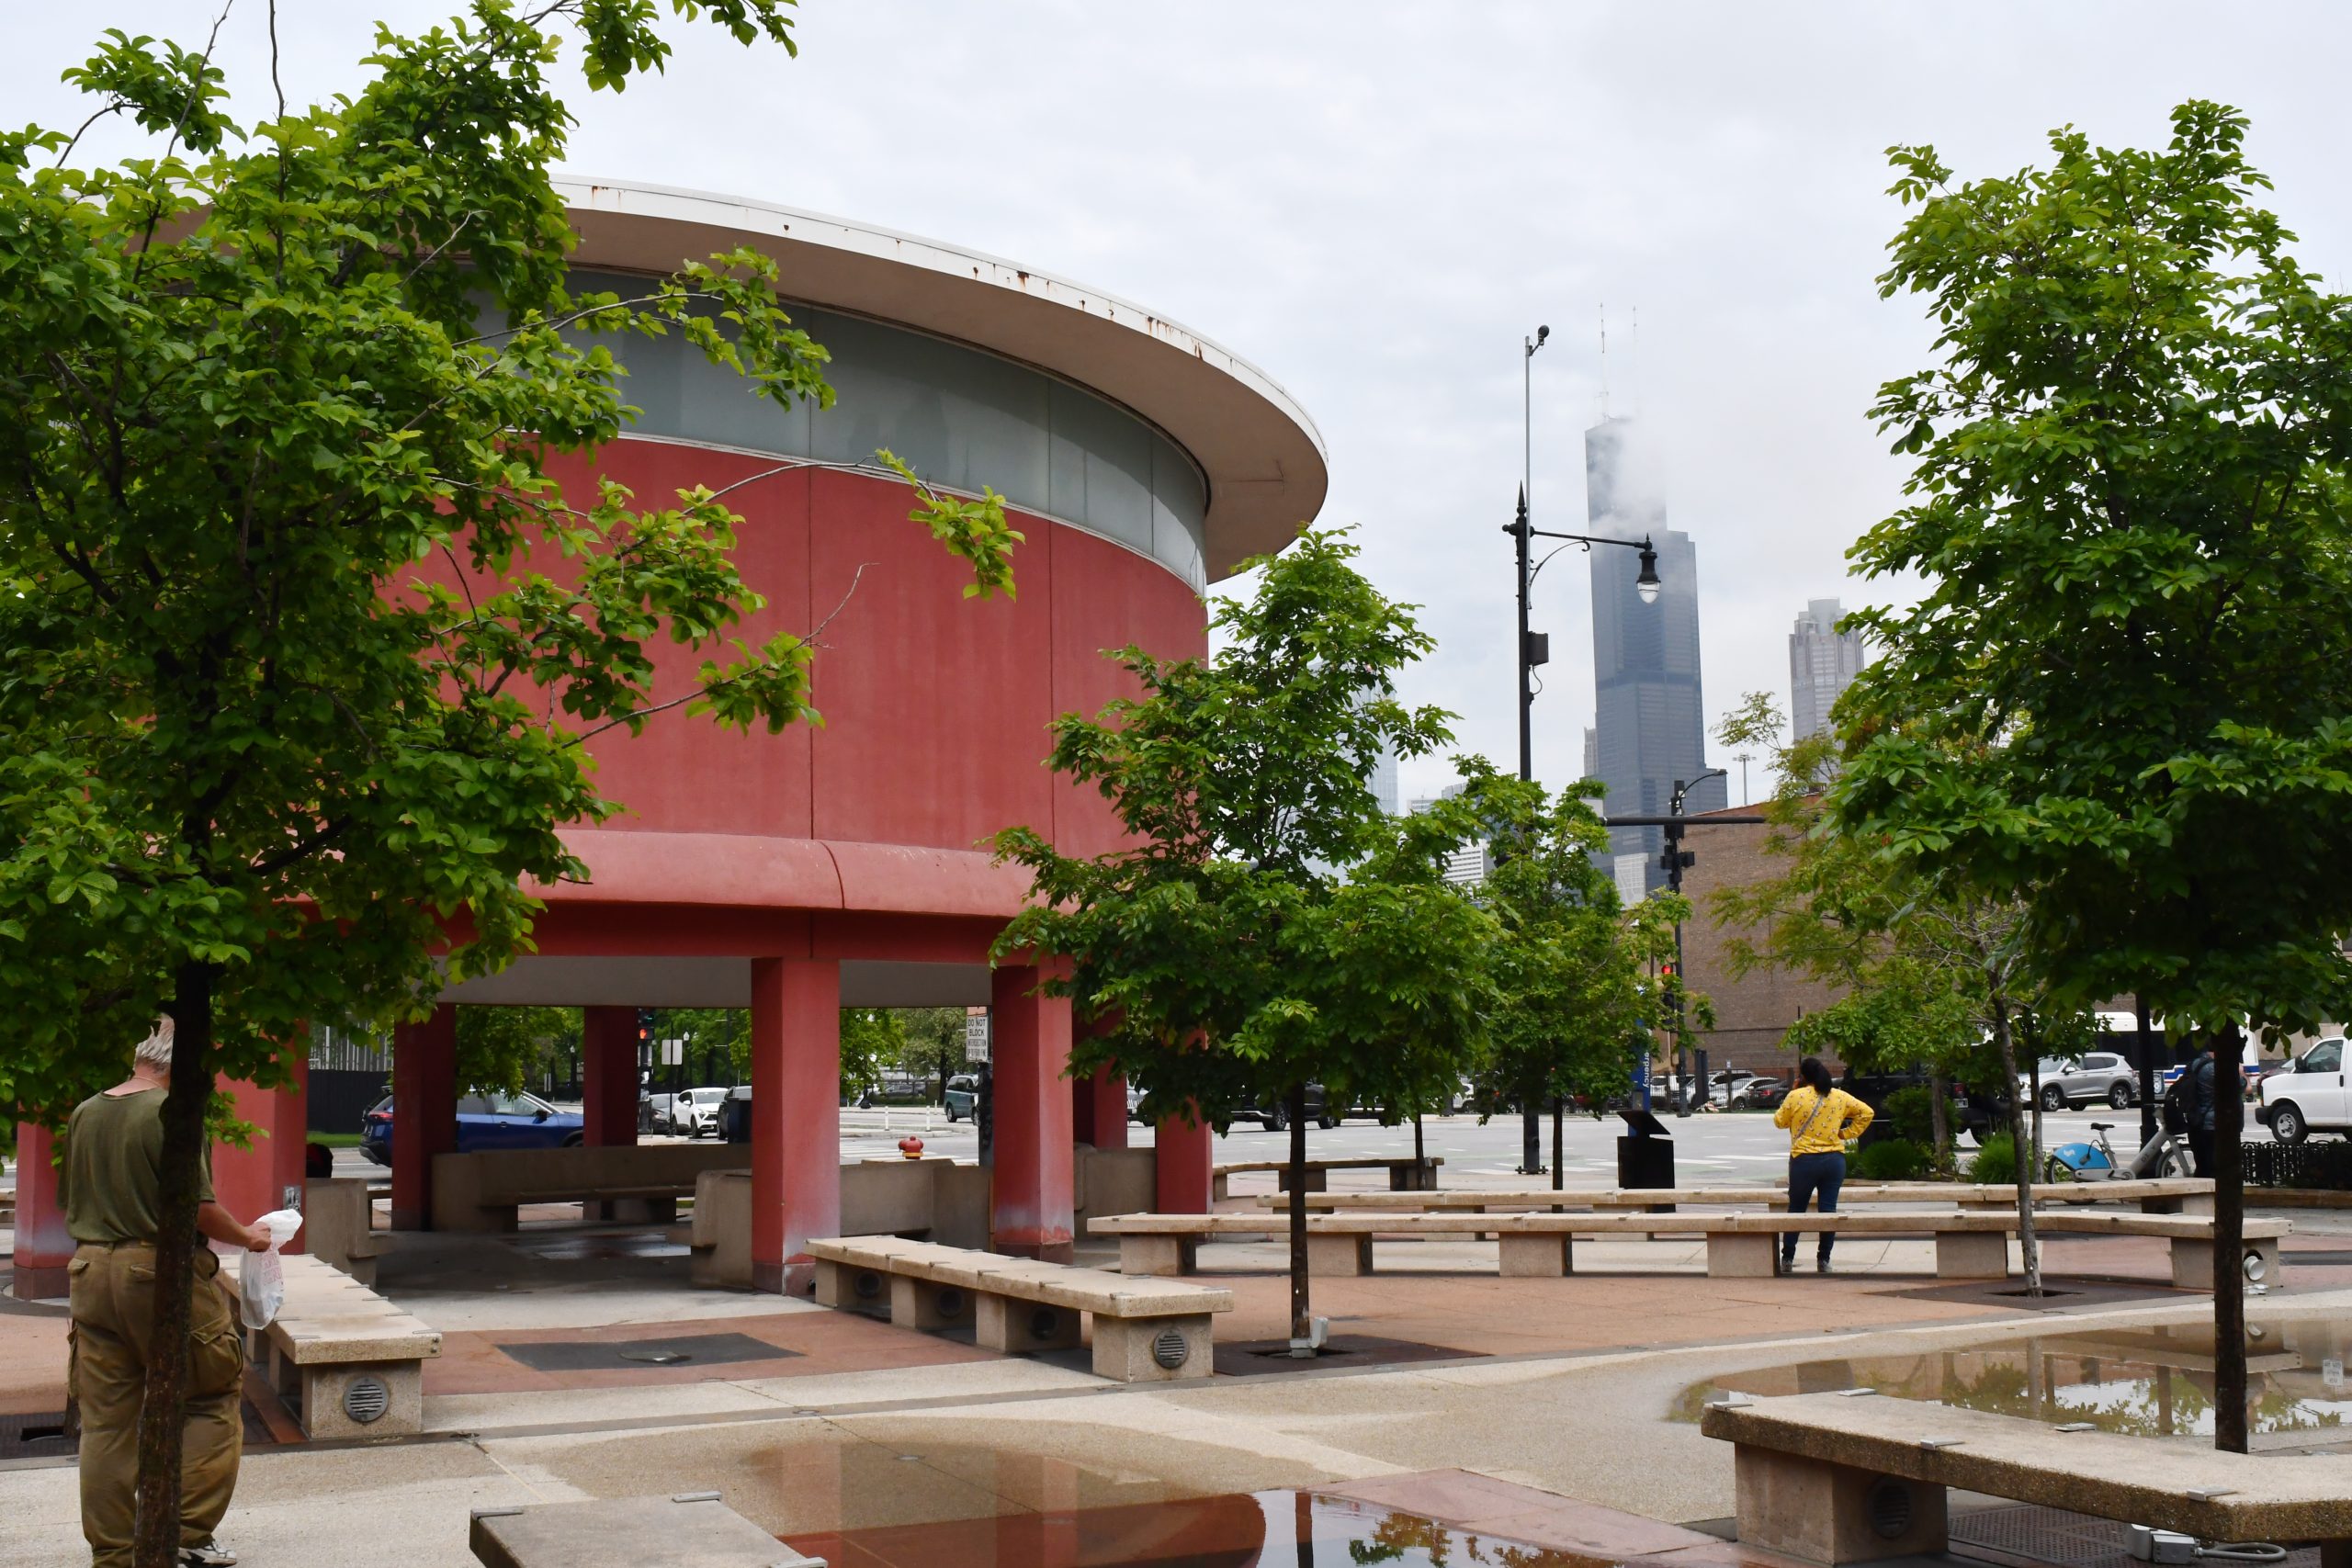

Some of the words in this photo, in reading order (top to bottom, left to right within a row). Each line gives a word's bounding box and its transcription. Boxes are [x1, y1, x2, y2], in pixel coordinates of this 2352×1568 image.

[976, 1019, 986, 1027] NOT
[968, 1029, 984, 1037] BLOCK
[1642, 1051, 1650, 1089] ergency
